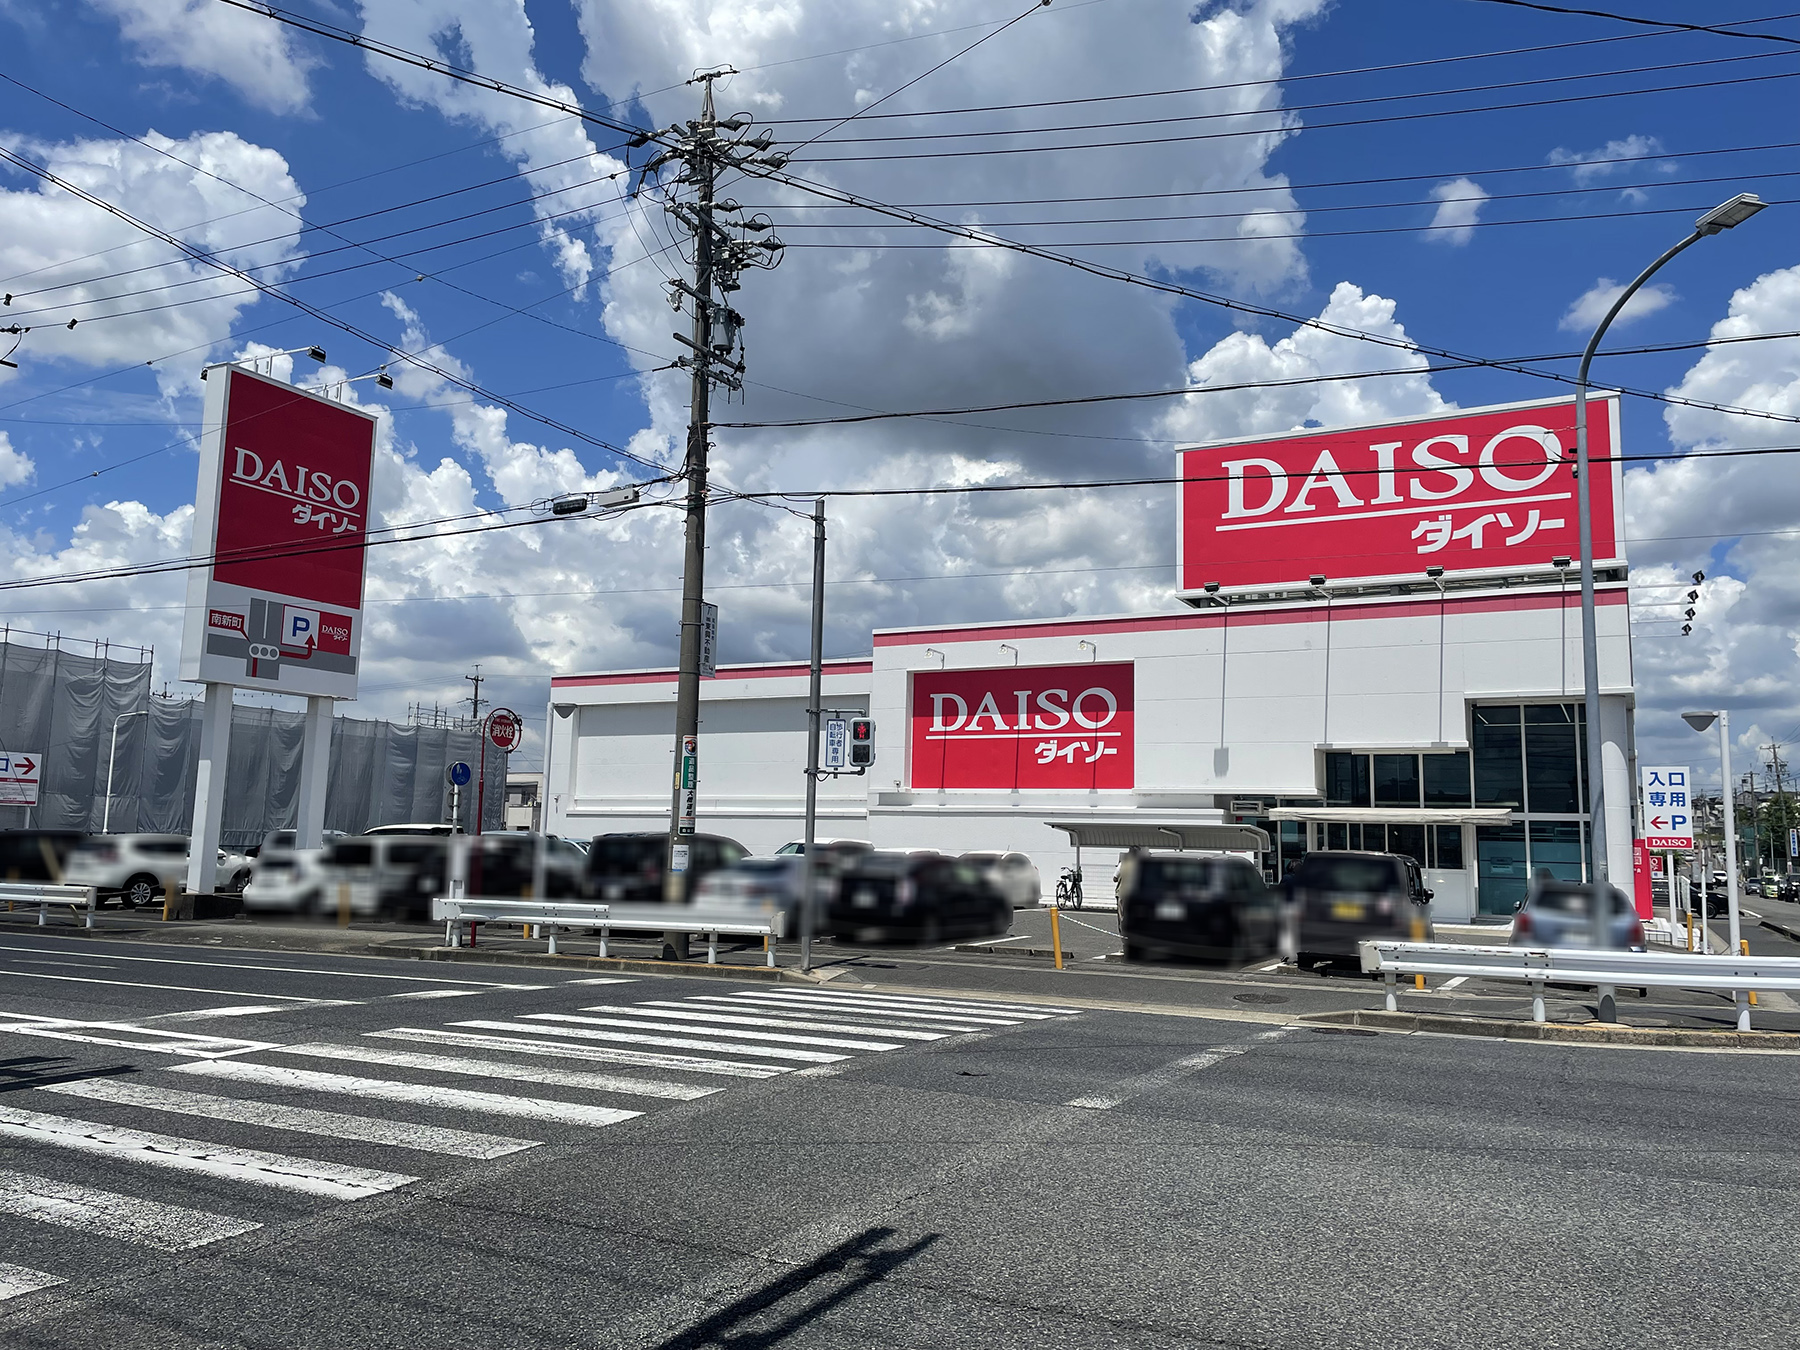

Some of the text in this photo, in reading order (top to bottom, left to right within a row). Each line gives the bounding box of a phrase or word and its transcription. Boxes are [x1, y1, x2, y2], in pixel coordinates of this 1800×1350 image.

[232, 446, 360, 509] DAISO
[1221, 424, 1563, 520] DAISO
[292, 504, 357, 533] ダイソー
[1411, 510, 1565, 554] ダイソー
[211, 613, 242, 628] 南新町
[292, 616, 310, 637] P
[321, 624, 349, 636] DAISO
[929, 687, 1118, 732] DAISO
[492, 723, 514, 739] 消火栓
[1034, 739, 1118, 764] ダイソー
[1648, 771, 1685, 786] 入口
[1648, 791, 1686, 807] 専用
[1671, 815, 1687, 831] P
[1652, 838, 1687, 846] DAISO
